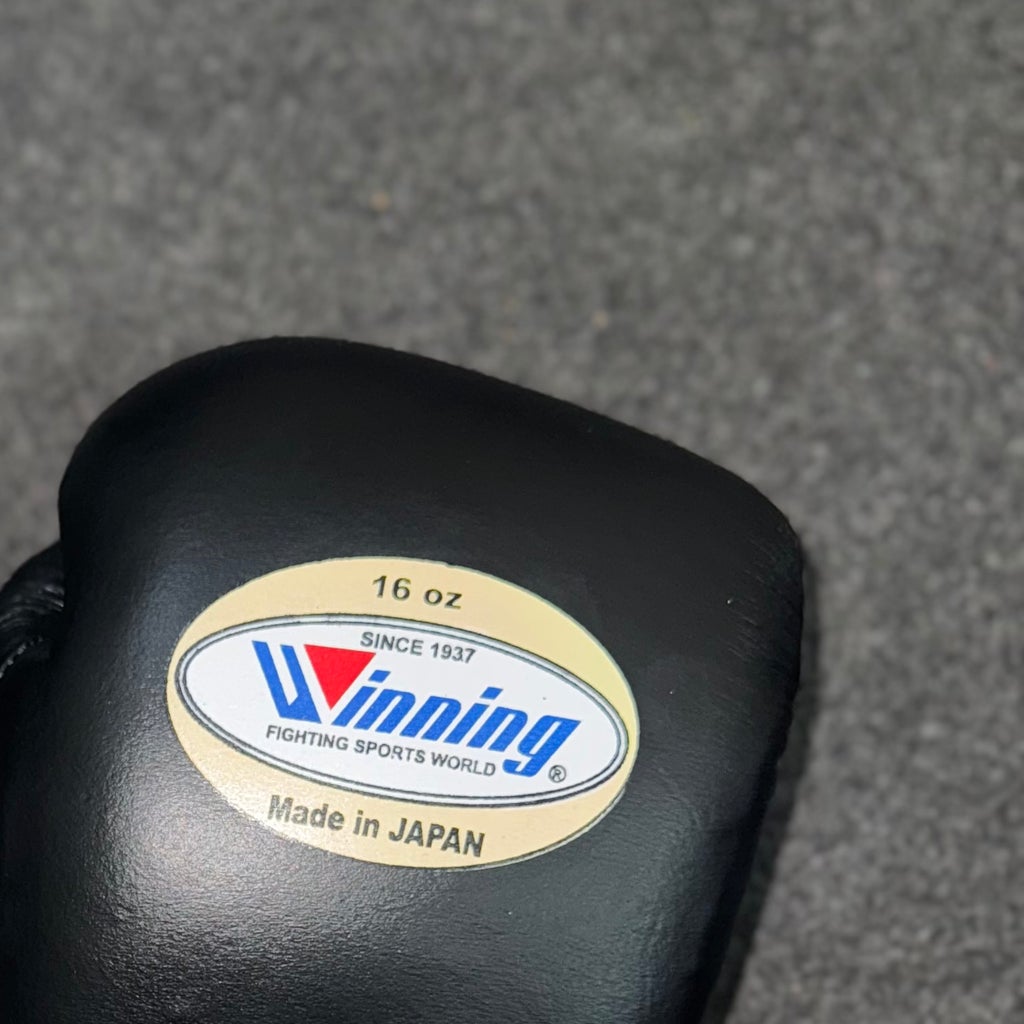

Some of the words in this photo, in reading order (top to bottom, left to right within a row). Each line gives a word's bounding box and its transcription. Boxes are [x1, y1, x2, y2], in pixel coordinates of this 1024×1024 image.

[372, 575, 411, 601] 16
[425, 588, 463, 609] oz
[360, 631, 423, 656] SINCE
[430, 643, 476, 664] 1937
[251, 640, 581, 778] Winning
[266, 724, 349, 751] FIGHTING
[353, 740, 426, 765] SPORTS
[431, 753, 496, 777] WORLD
[268, 794, 345, 831] Made
[353, 811, 381, 838] in
[389, 817, 485, 858] JAPAN
